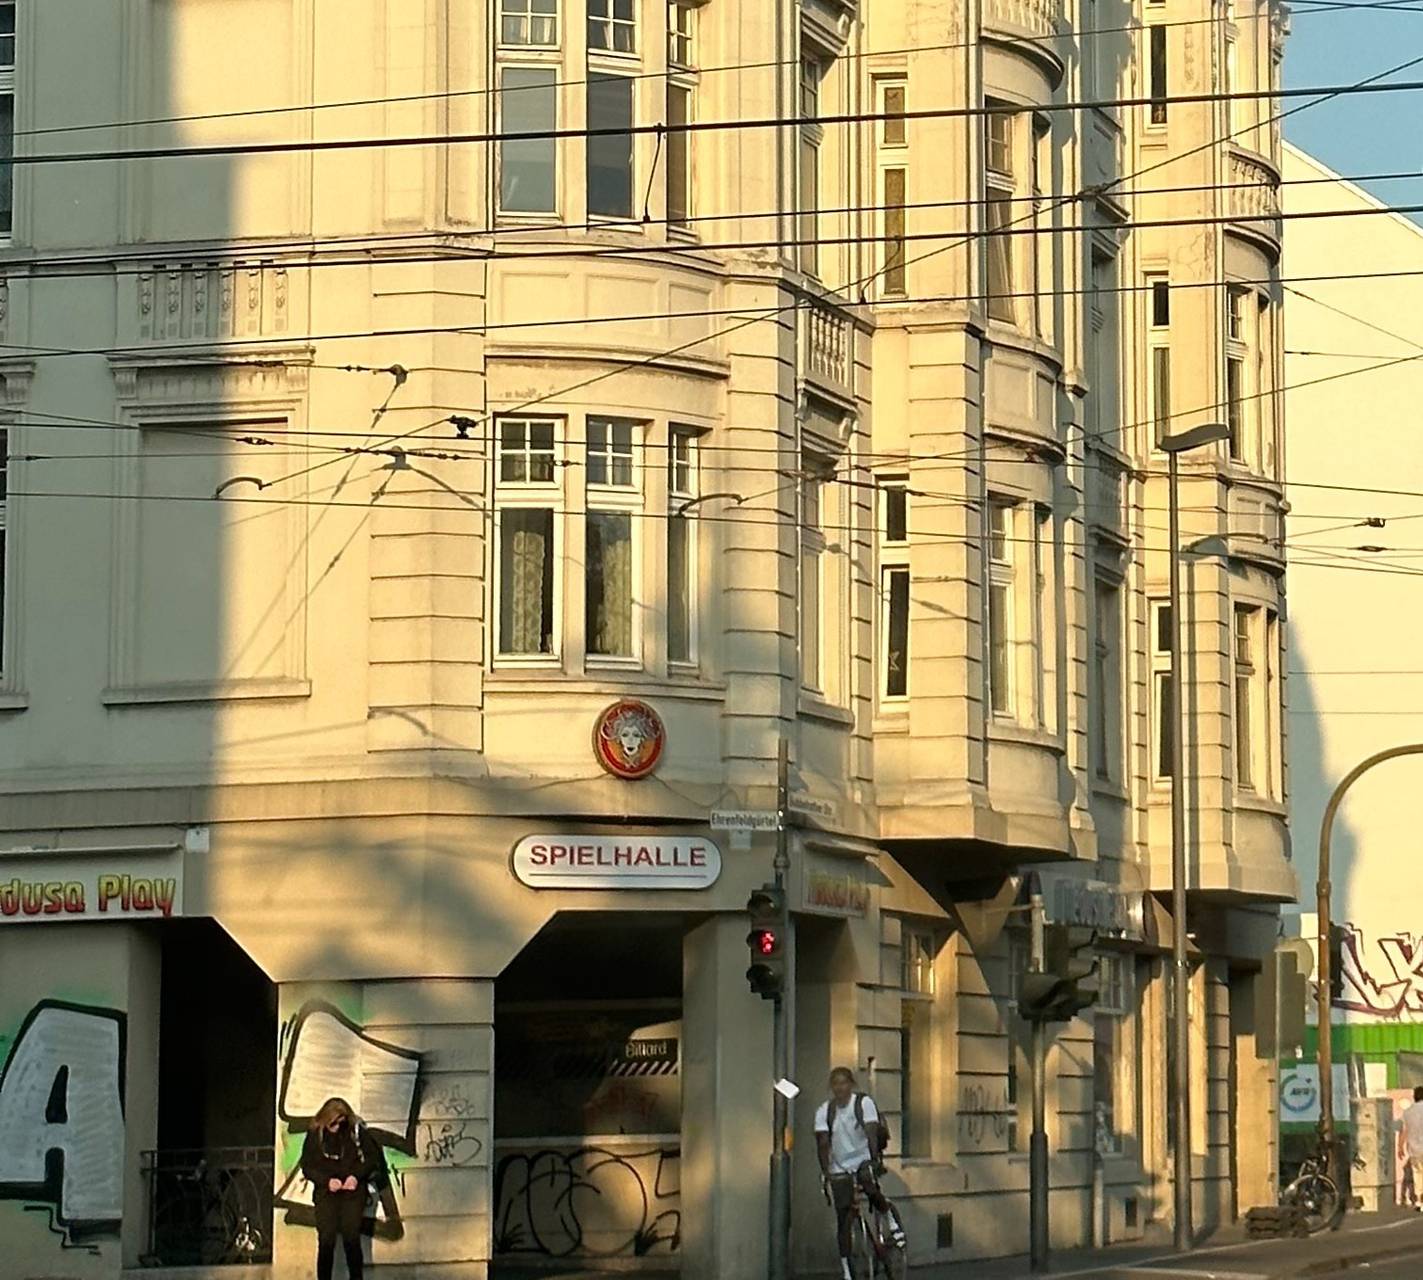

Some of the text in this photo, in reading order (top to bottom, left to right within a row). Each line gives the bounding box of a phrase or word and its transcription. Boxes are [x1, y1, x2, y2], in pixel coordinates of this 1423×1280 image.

[529, 845, 706, 868] SPIELHALLE
[97, 874, 177, 918] Play
[625, 1041, 667, 1058] Billard
